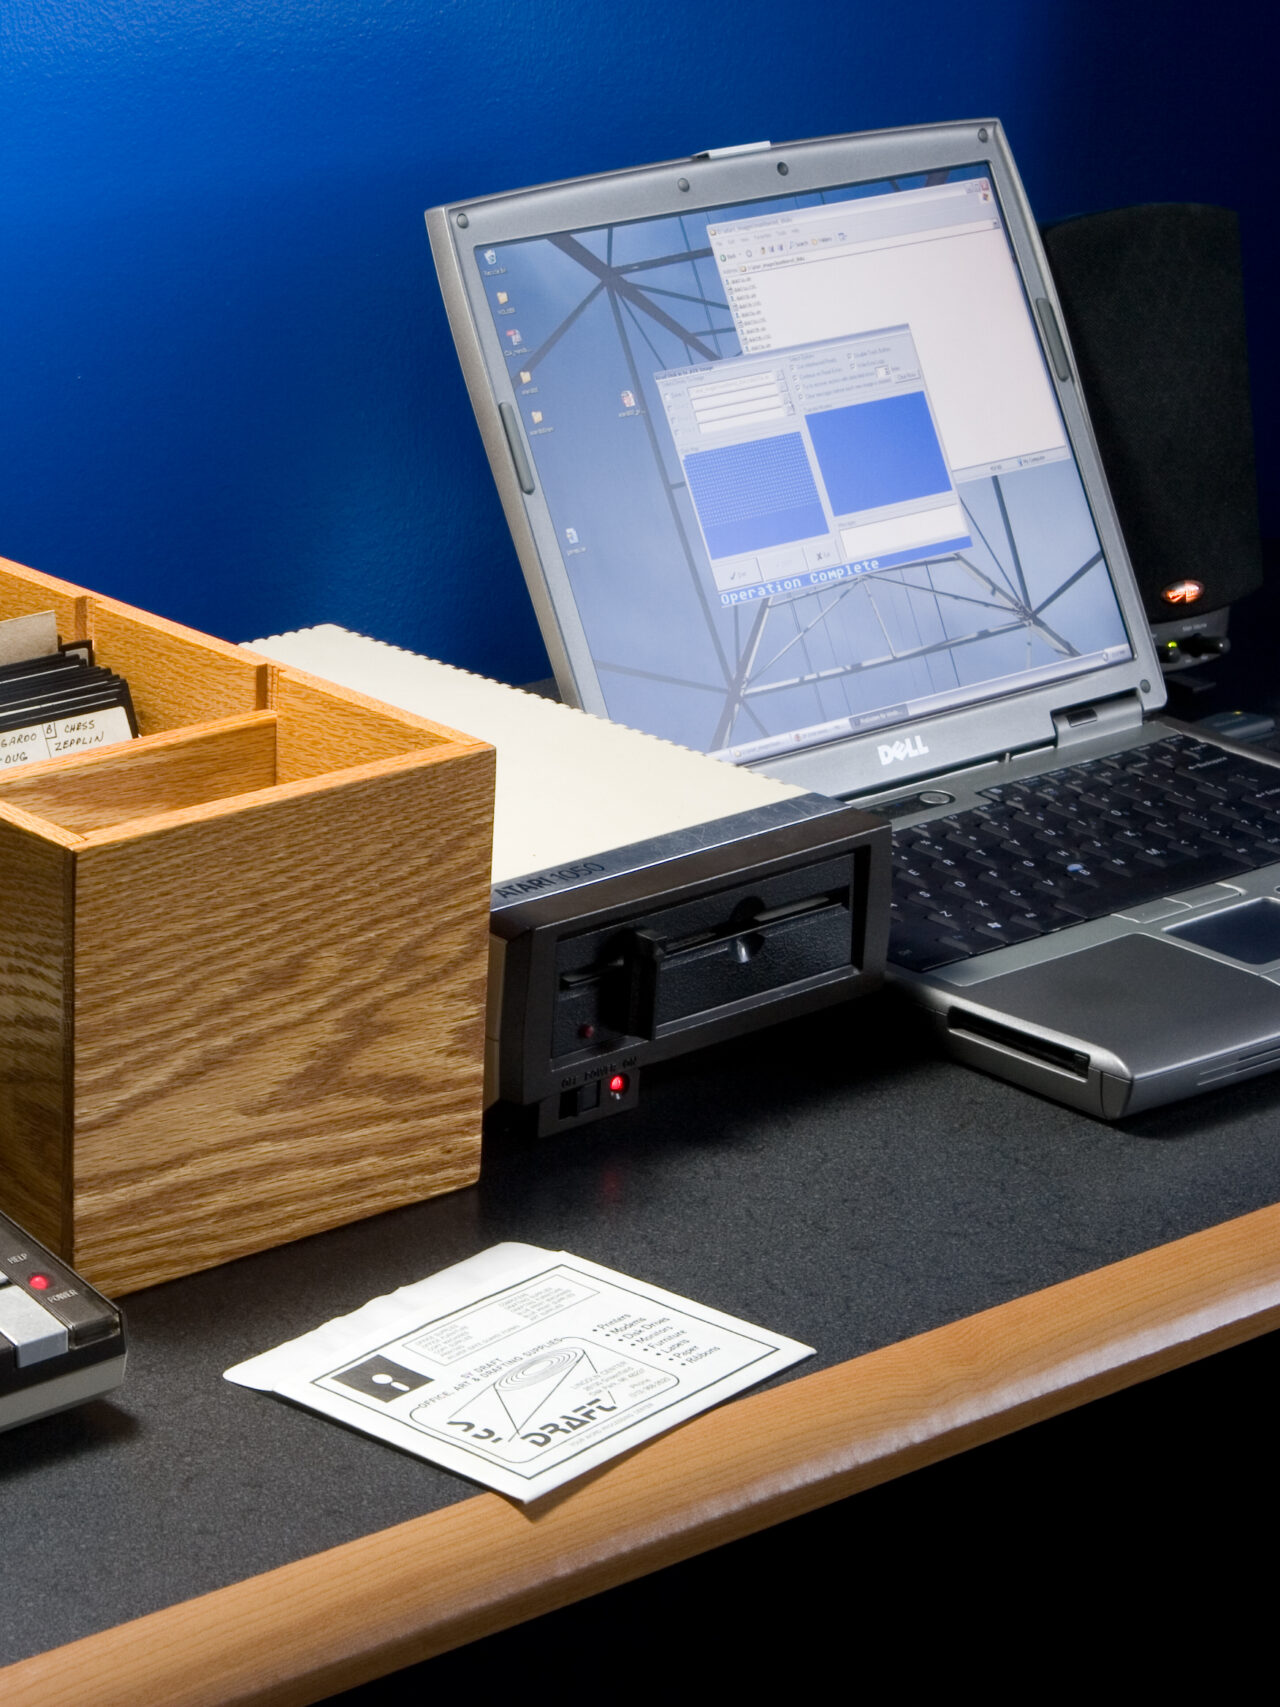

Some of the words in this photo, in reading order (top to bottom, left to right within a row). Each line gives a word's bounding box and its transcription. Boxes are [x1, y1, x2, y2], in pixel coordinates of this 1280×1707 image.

[721, 578, 801, 605] Operation
[810, 559, 879, 584] Complete
[64, 720, 96, 733] CHESS
[54, 731, 104, 751] ZEPPLIN
[877, 735, 929, 765] DELL
[495, 876, 556, 899] ATARI
[551, 862, 605, 881] 1050
[7, 1253, 28, 1265] HELP
[47, 1289, 78, 1304] POWER
[595, 1312, 632, 1329] Printers
[608, 1316, 647, 1334] Modems
[620, 1327, 645, 1339] Disk
[639, 1315, 670, 1330] Drives
[634, 1325, 674, 1343] Monitors
[646, 1328, 688, 1348] Furniture
[672, 1344, 701, 1358] Paper
[451, 1380, 472, 1390] ART
[479, 1356, 524, 1377] DRAFTING
[521, 1337, 563, 1357] SUPPLIES
[472, 1357, 504, 1372] DRAFT
[520, 1398, 617, 1447] DRAFT
